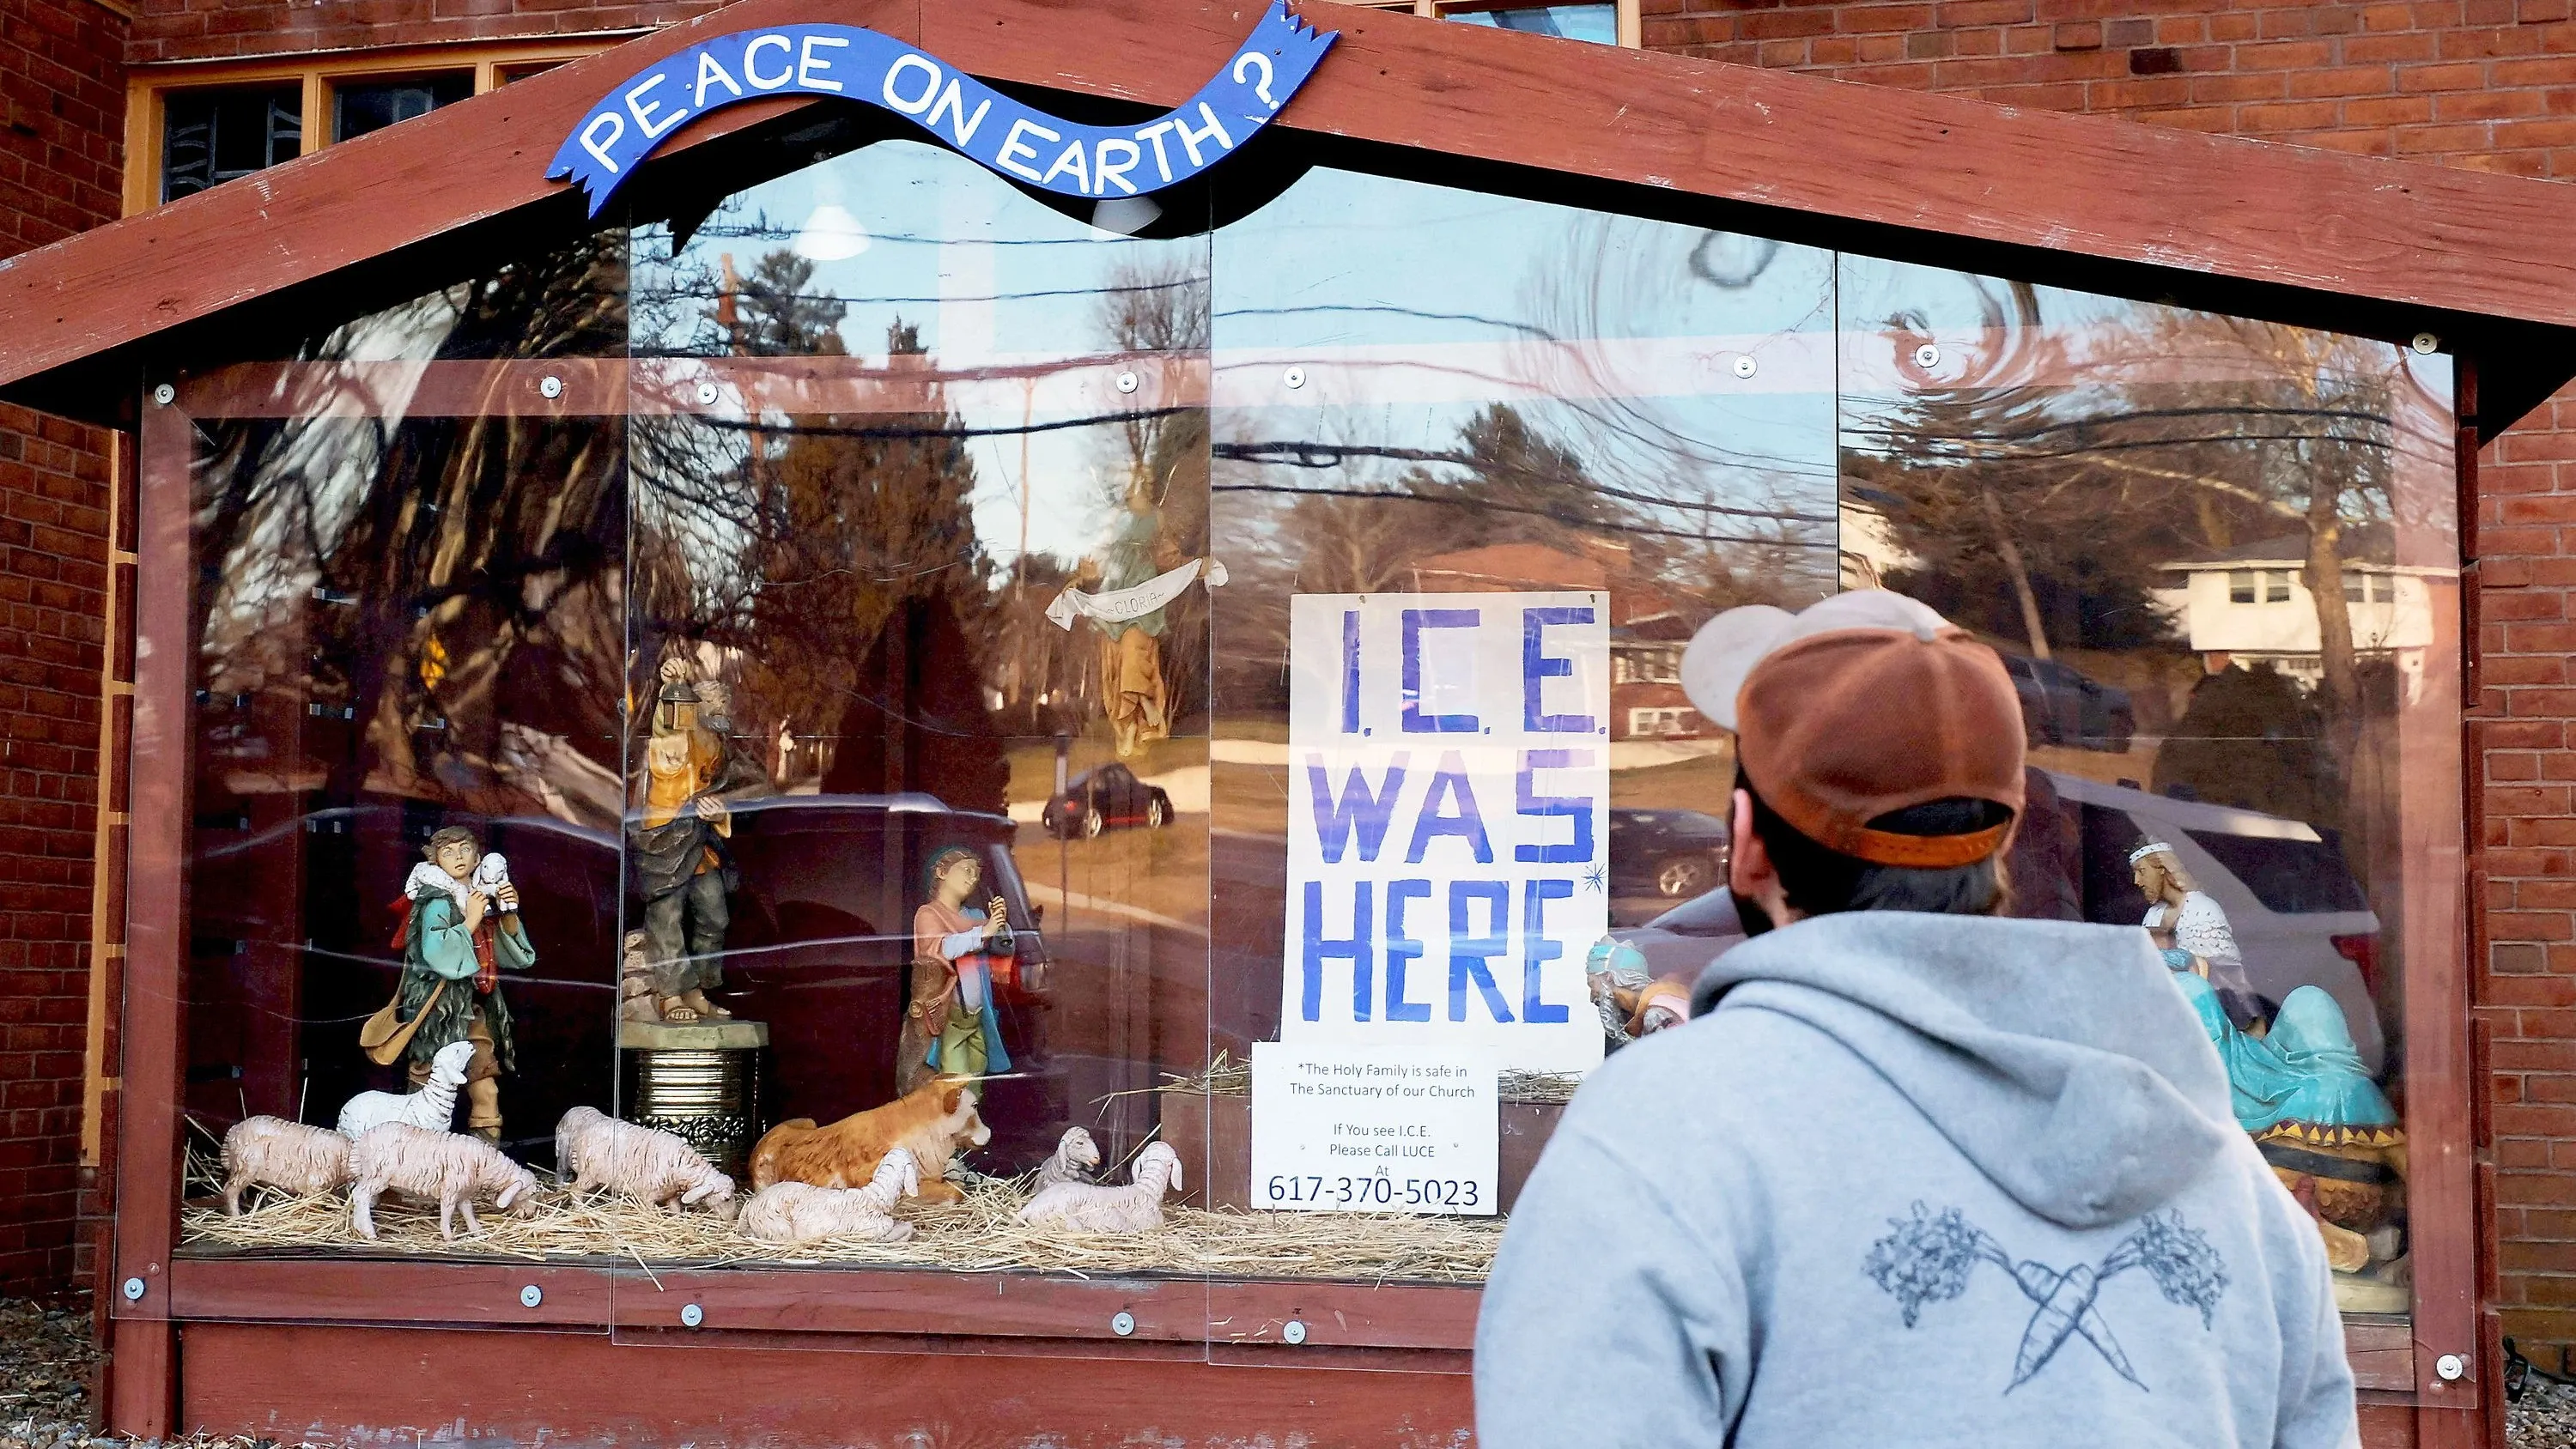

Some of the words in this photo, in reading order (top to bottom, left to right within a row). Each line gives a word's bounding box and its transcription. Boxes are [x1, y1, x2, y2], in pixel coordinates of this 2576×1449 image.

[579, 35, 850, 174] PEACE
[882, 53, 992, 149] ON
[996, 100, 1233, 196] EARTH
[1341, 607, 1607, 737] I.C.E.
[1304, 749, 1595, 864] WAS
[1334, 1063, 1362, 1078] Holy
[1366, 1064, 1407, 1078] Family
[1412, 1064, 1421, 1076] is
[1425, 1064, 1451, 1076] safe
[1455, 1065, 1467, 1076] in
[1289, 1082, 1313, 1094] The
[1317, 1082, 1382, 1098] Sanctuary
[1386, 1083, 1399, 1096] of
[1402, 1087, 1425, 1096] our
[1429, 1084, 1474, 1097] Church
[1334, 1123, 1342, 1135] If
[1346, 1124, 1368, 1136] You
[1373, 1127, 1394, 1136] see
[1399, 1125, 1430, 1137] I.C.E.
[1329, 1143, 1370, 1155] Please
[1375, 1144, 1397, 1156] Call
[1402, 1145, 1434, 1157] LUCE
[1375, 1165, 1388, 1176] At
[1268, 1175, 1479, 1206] 617-370-5023
